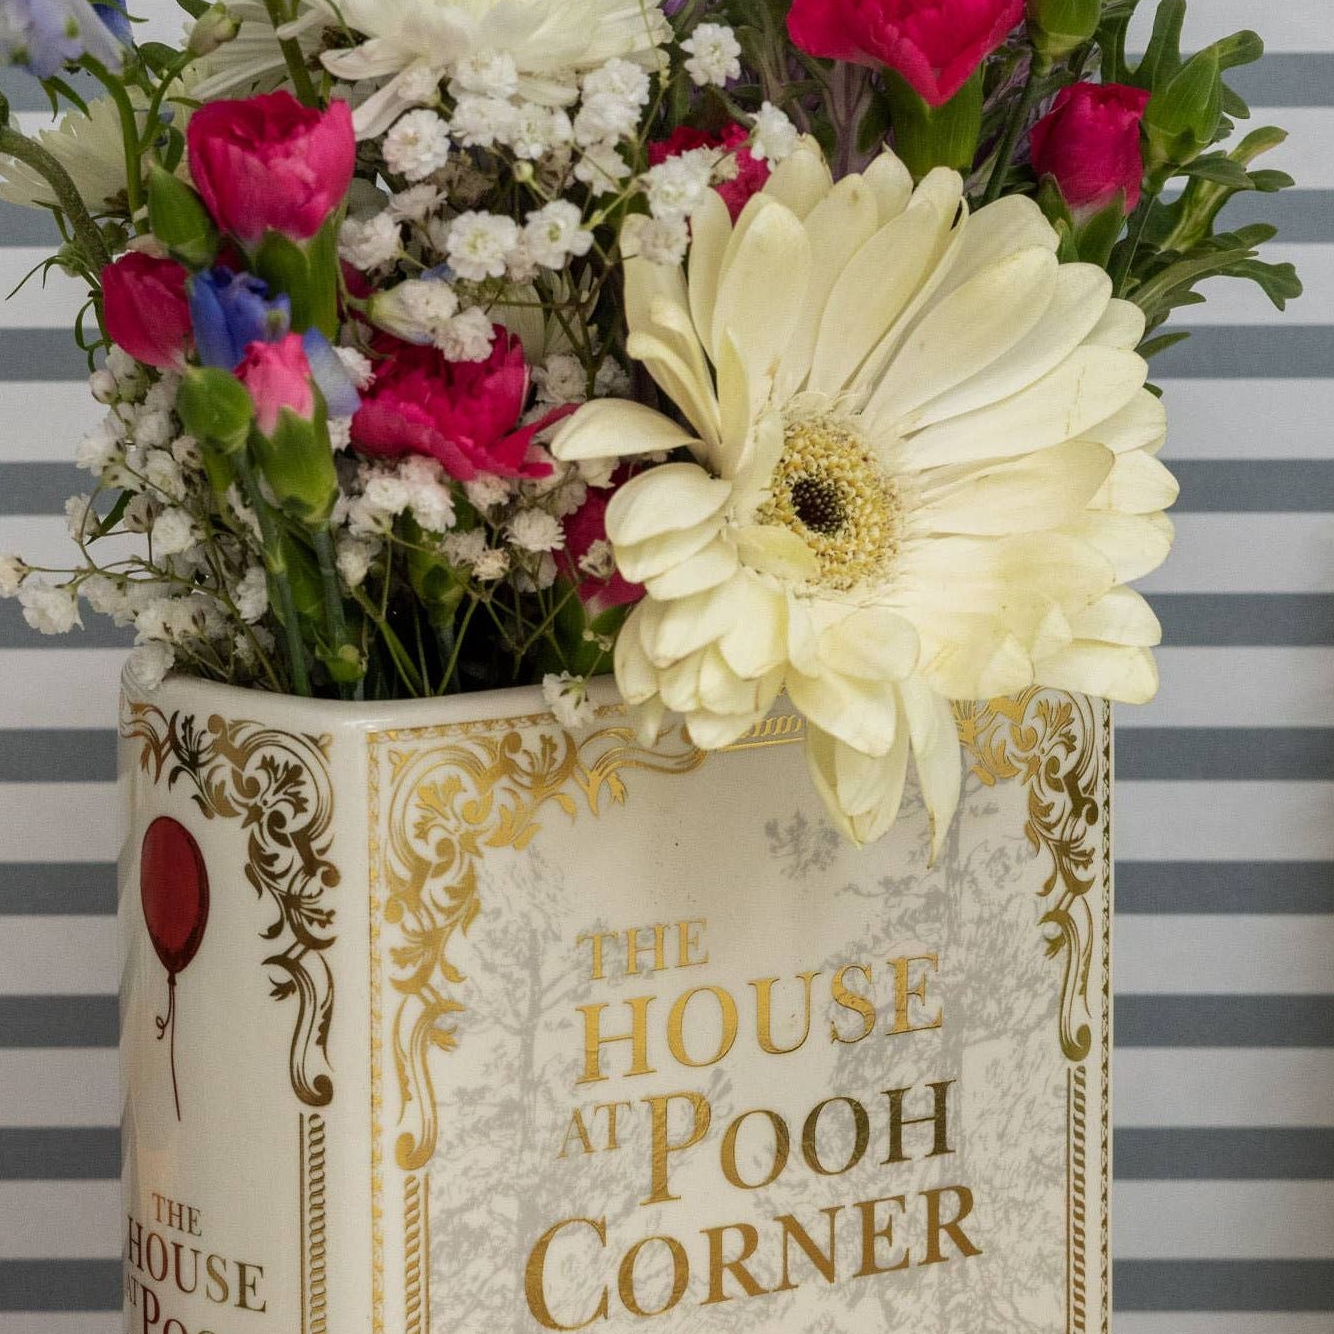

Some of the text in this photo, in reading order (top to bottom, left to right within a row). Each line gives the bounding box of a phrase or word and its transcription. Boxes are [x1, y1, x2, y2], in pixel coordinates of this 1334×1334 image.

[575, 917, 710, 981] THE
[574, 951, 944, 1085] HOUSE
[557, 1079, 958, 1206] AT POOH
[127, 1214, 267, 1313] HOUSE
[151, 1192, 203, 1237] THE
[524, 1184, 984, 1332] CORNER
